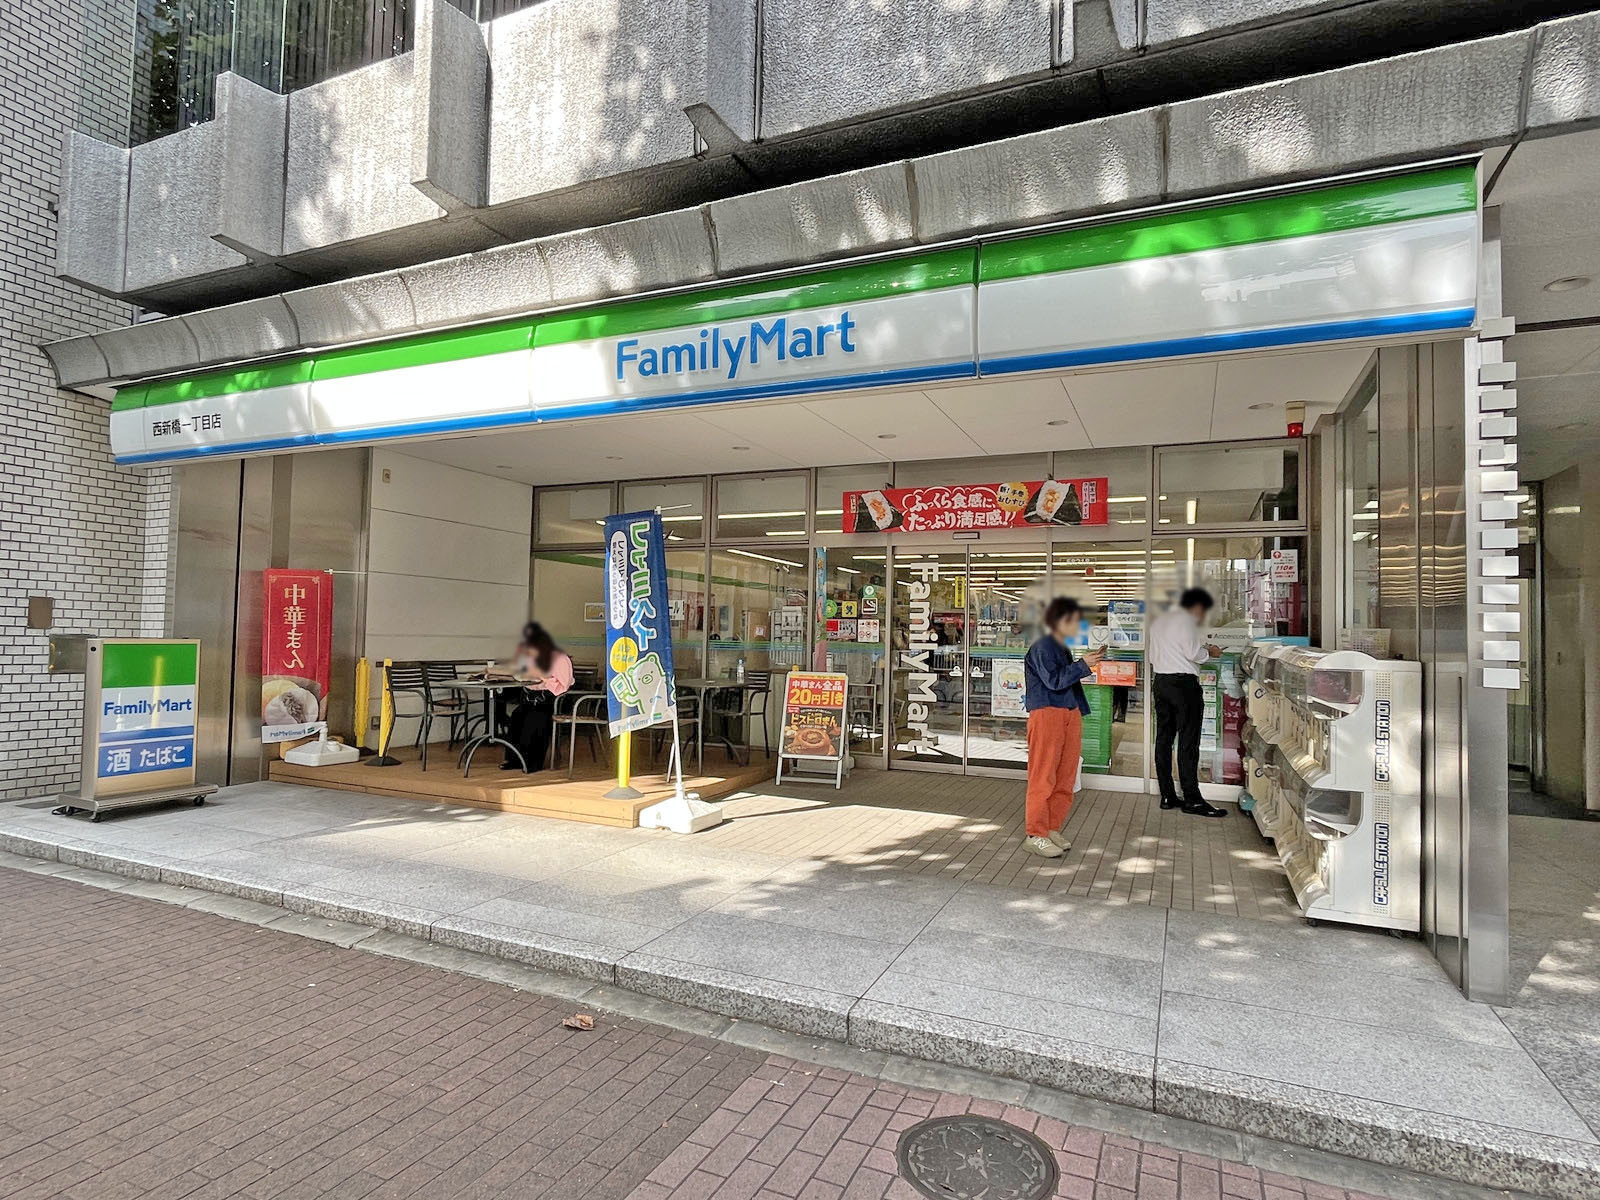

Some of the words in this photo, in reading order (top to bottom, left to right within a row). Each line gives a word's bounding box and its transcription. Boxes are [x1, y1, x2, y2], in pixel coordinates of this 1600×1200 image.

[616, 311, 855, 380] FamilyMart
[152, 413, 221, 437] 西新橋一丁目店
[910, 492, 996, 512] ふっくら食感に、
[900, 562, 939, 754] FamilyMart
[789, 688, 844, 705] 20円引き
[792, 680, 843, 691] 中華まん全品
[104, 699, 192, 716] FamilyMart
[1375, 700, 1391, 740] STATION
[106, 748, 132, 773] 酒
[139, 746, 186, 767] たばこ
[1374, 738, 1390, 782] CAPSULE
[1374, 822, 1390, 862] STATION
[1373, 861, 1389, 906] CAPSULE
